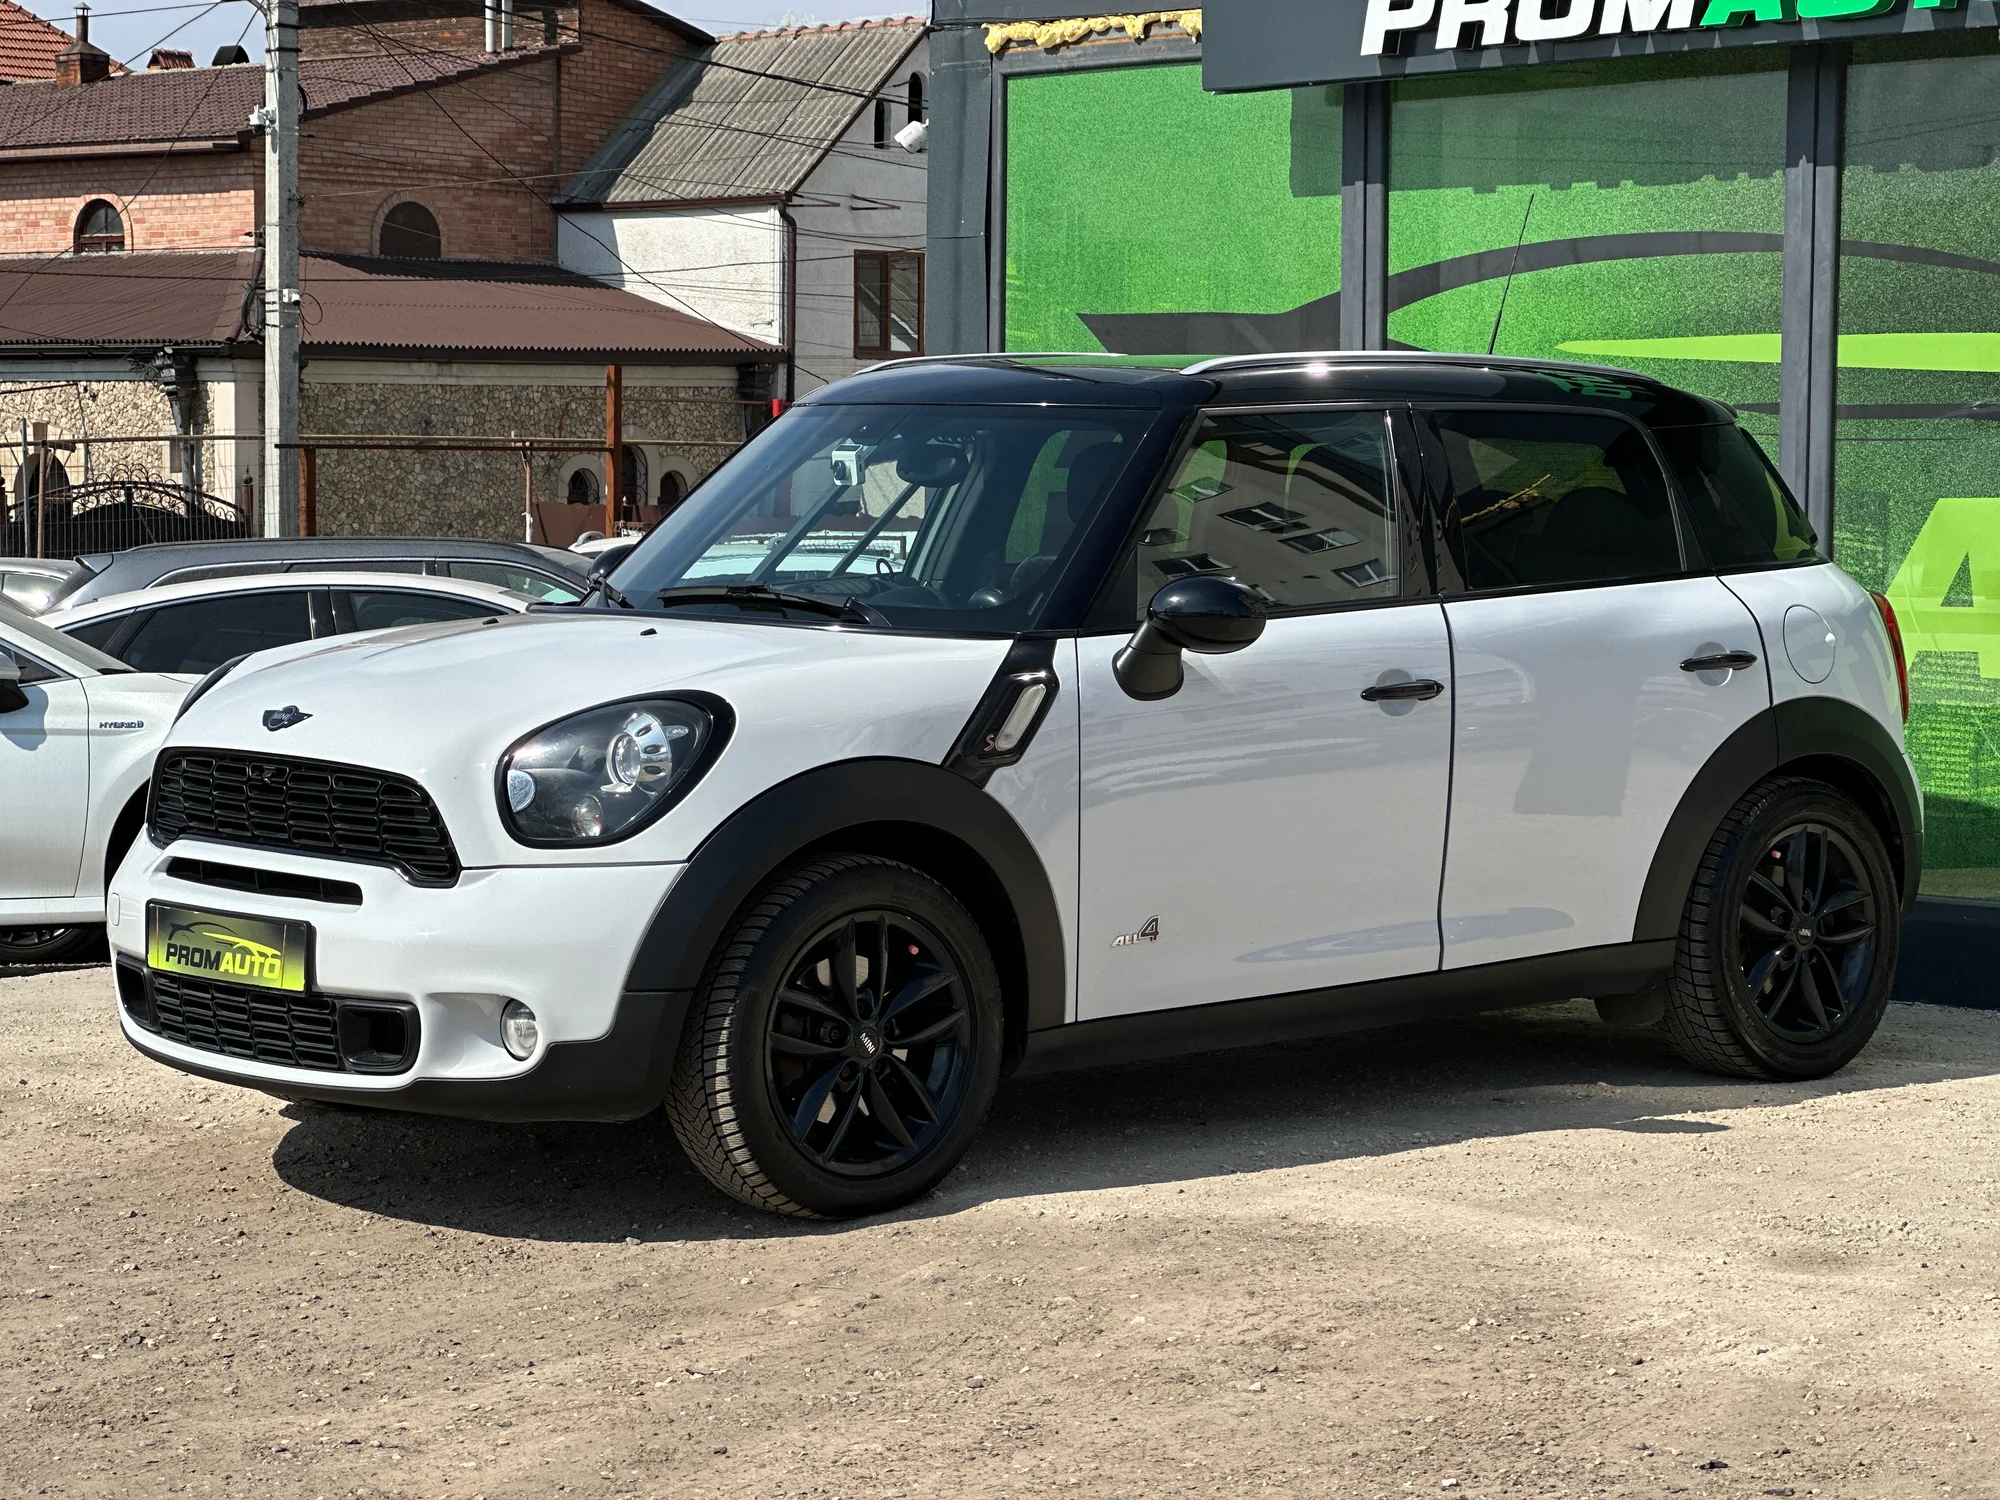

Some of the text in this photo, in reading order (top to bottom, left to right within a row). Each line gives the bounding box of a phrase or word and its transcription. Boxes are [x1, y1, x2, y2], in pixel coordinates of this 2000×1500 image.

[984, 733, 994, 751] S
[165, 942, 282, 979] PROMAUTO
[860, 1032, 876, 1054] MINI
